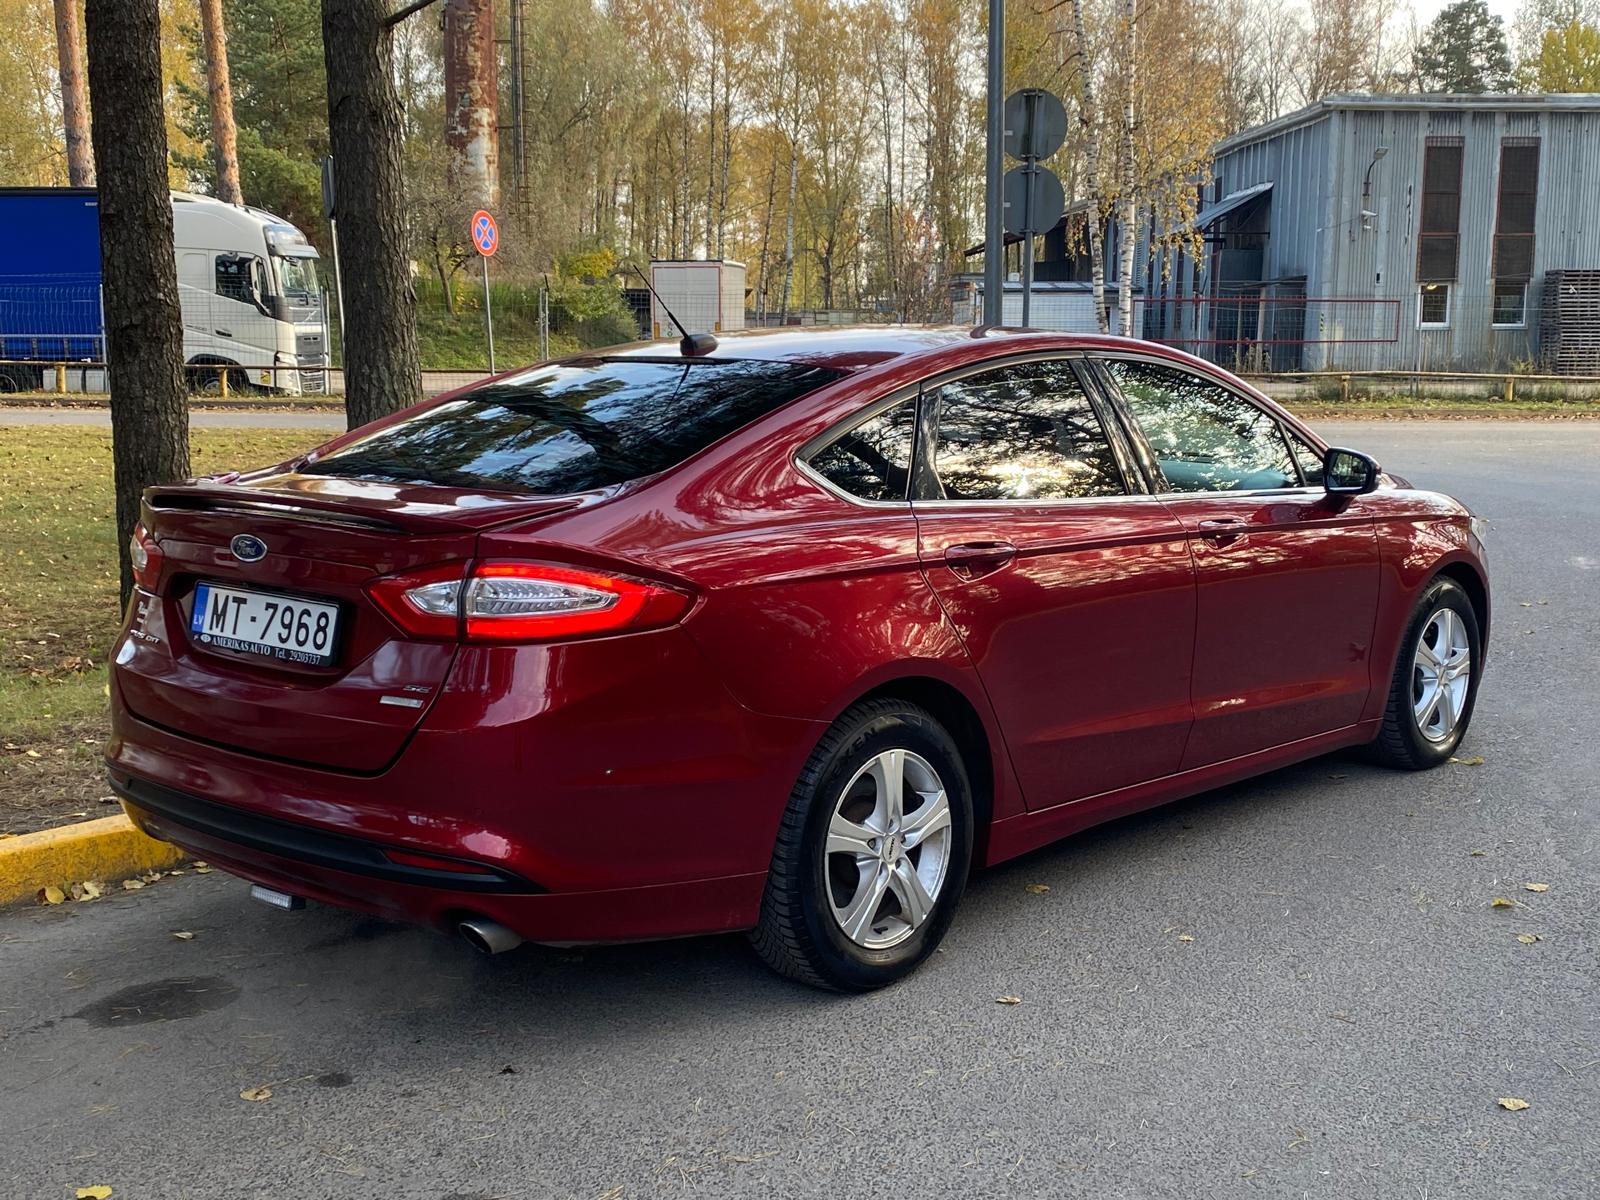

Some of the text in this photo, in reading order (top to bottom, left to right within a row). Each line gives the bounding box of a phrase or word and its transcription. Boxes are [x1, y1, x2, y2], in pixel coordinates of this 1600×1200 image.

[193, 615, 205, 626] LV
[209, 593, 330, 650] MT-7968
[212, 636, 250, 652] AMERIKAS
[249, 643, 271, 656] AUTO
